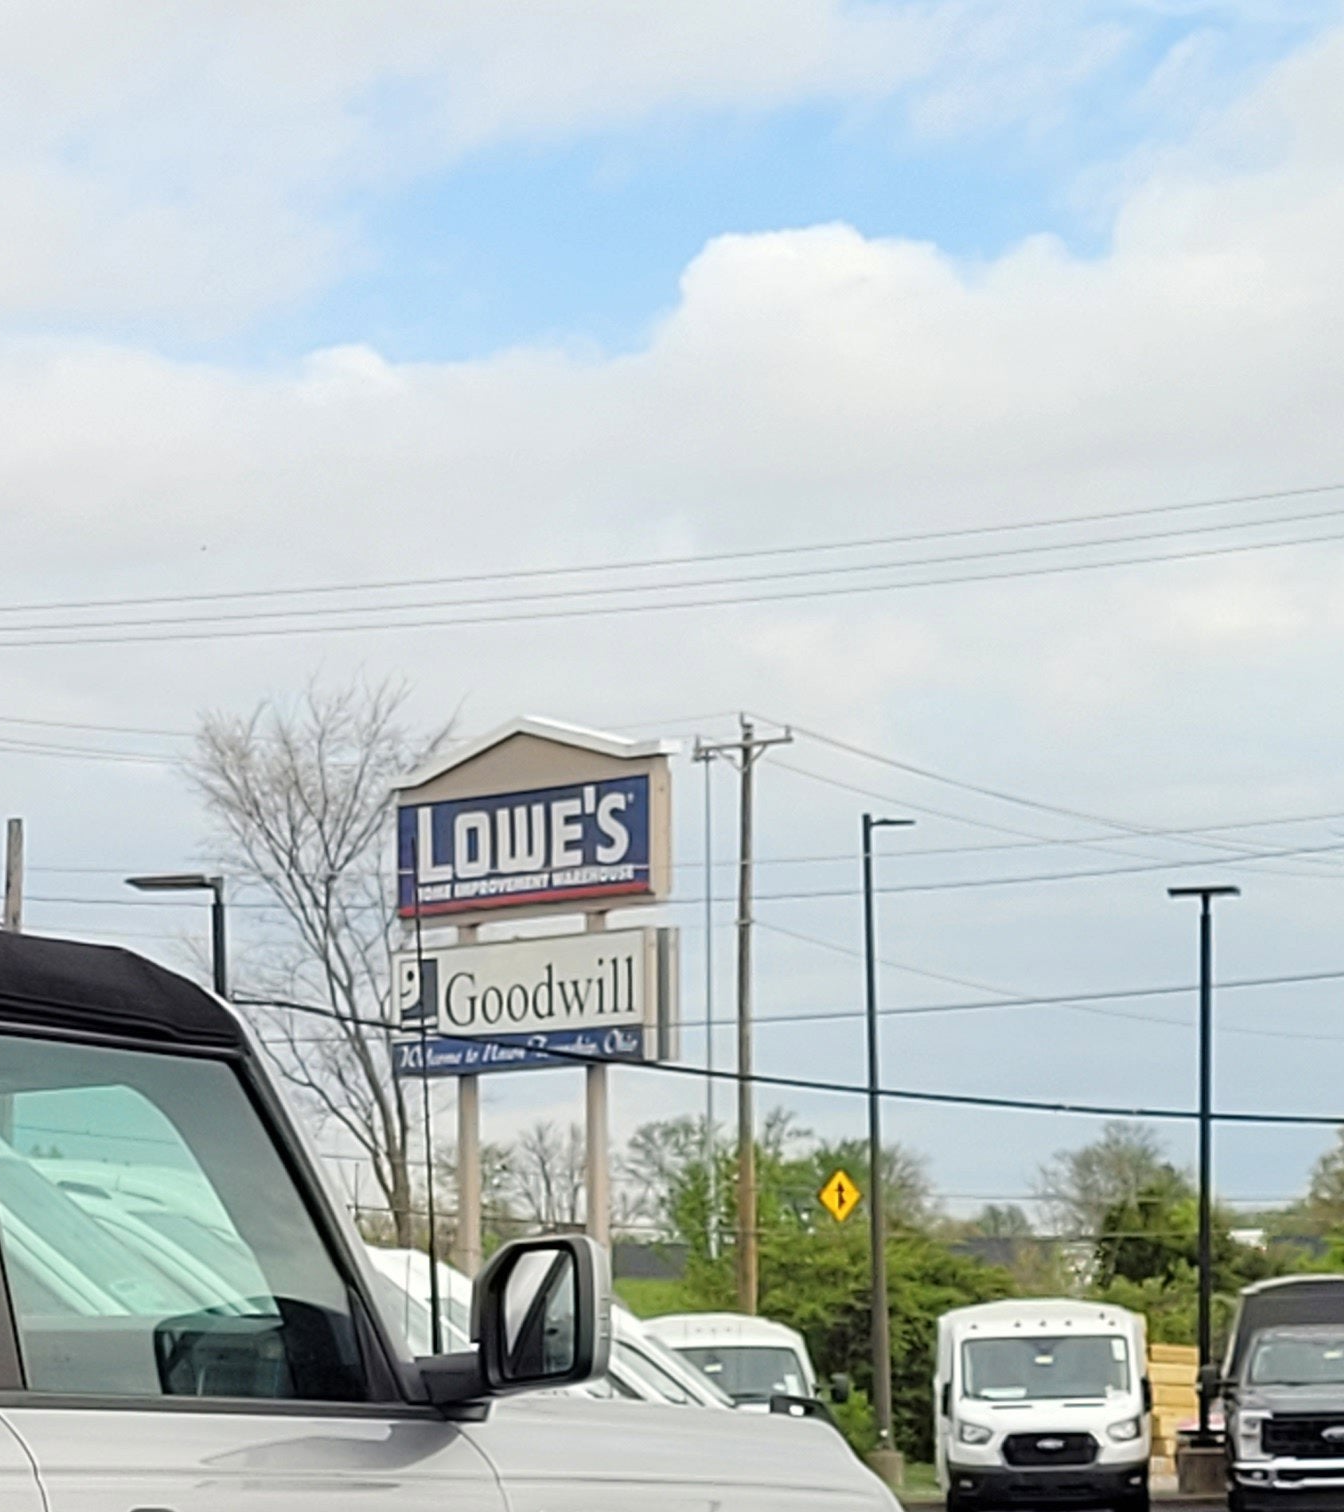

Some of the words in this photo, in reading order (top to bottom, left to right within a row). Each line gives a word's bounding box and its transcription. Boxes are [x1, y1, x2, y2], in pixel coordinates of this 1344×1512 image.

[416, 785, 630, 883] LOWE'S
[551, 864, 635, 886] WAREHOUSE
[444, 956, 637, 1027] Goodwill
